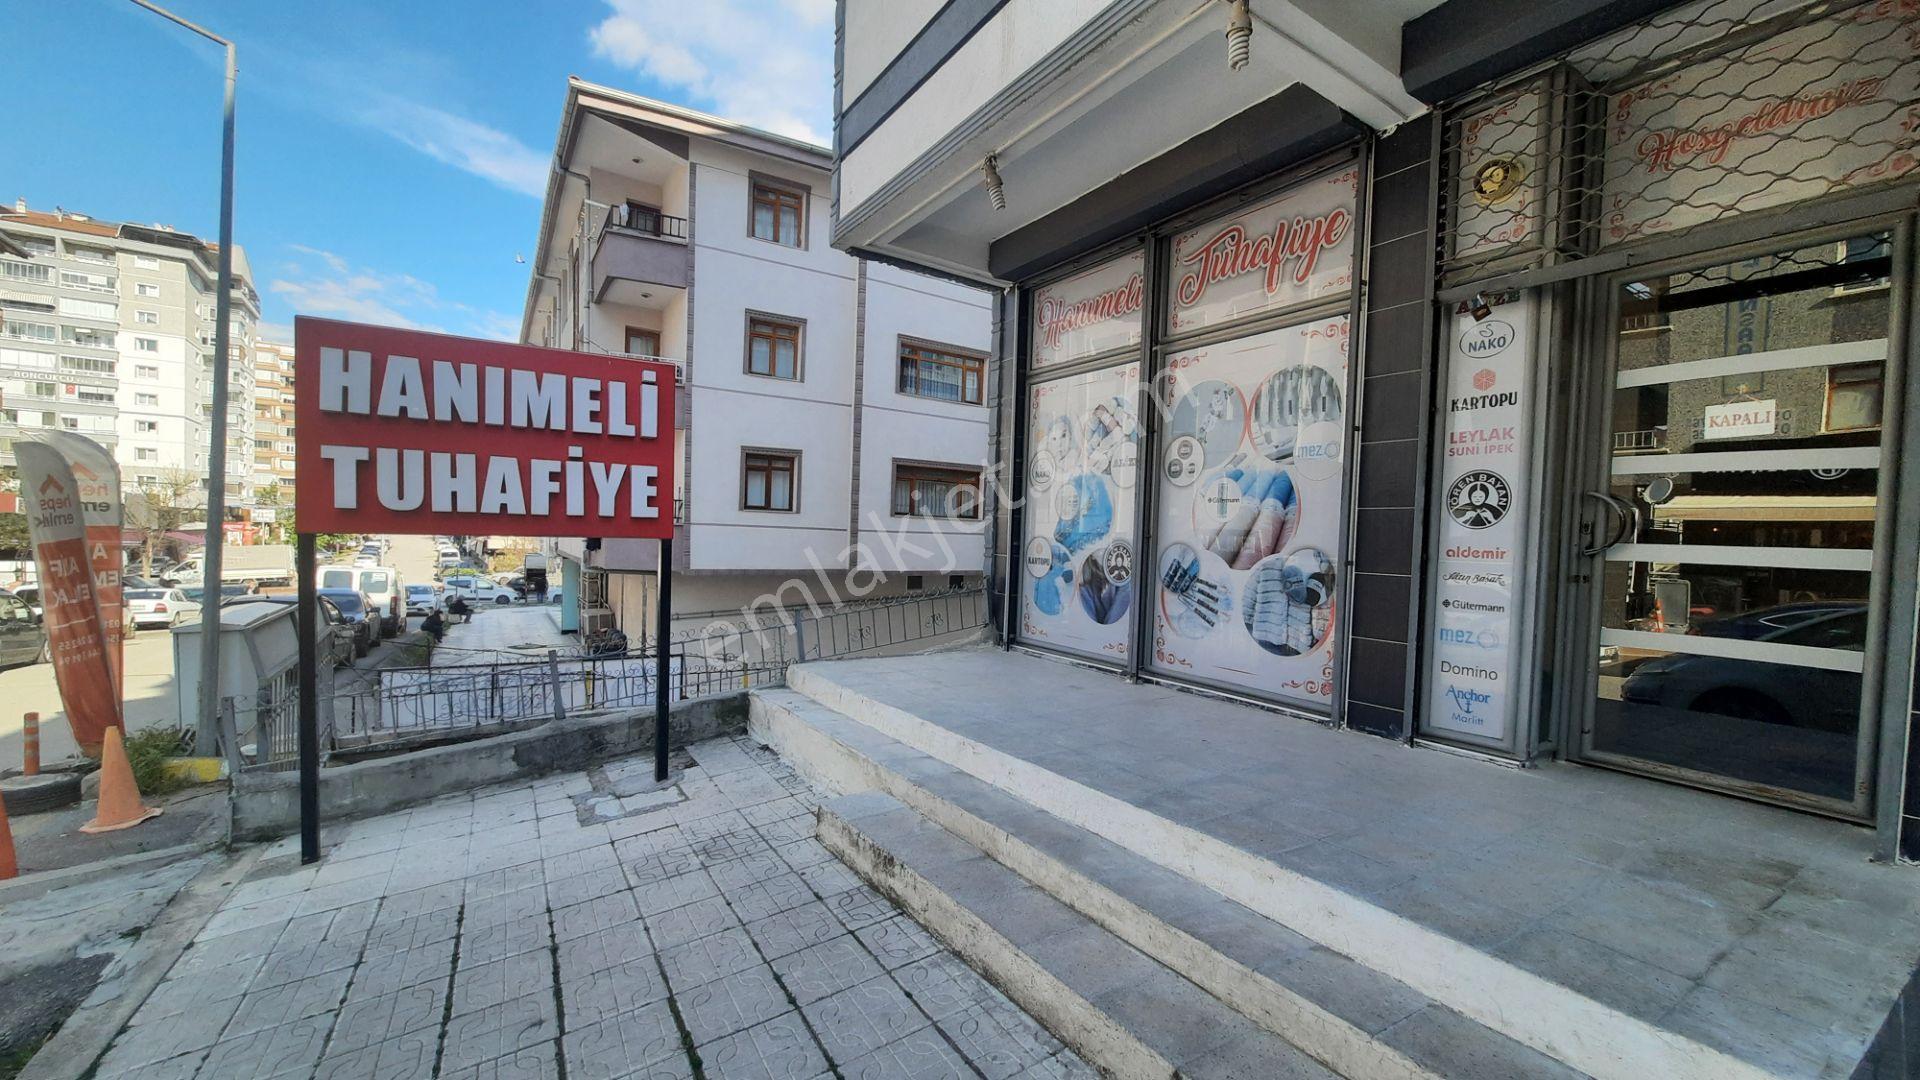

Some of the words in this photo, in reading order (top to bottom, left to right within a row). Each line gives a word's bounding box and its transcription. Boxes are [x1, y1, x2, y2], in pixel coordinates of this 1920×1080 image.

[1177, 208, 1351, 307] Tuhafiye
[1468, 334, 1507, 353] NAKO
[319, 346, 657, 438] HANIMELİ
[1451, 391, 1518, 413] KARTOPU
[1708, 410, 1773, 429] KAPALI
[1450, 427, 1515, 444] LEYLAK
[320, 445, 659, 519] TUHAFİYE
[1479, 473, 1508, 506] BAYAN
[1446, 546, 1506, 560] aldemir
[1452, 599, 1505, 613] Gütermann
[1440, 660, 1498, 681] Domino
[1445, 684, 1491, 707] Anchor
